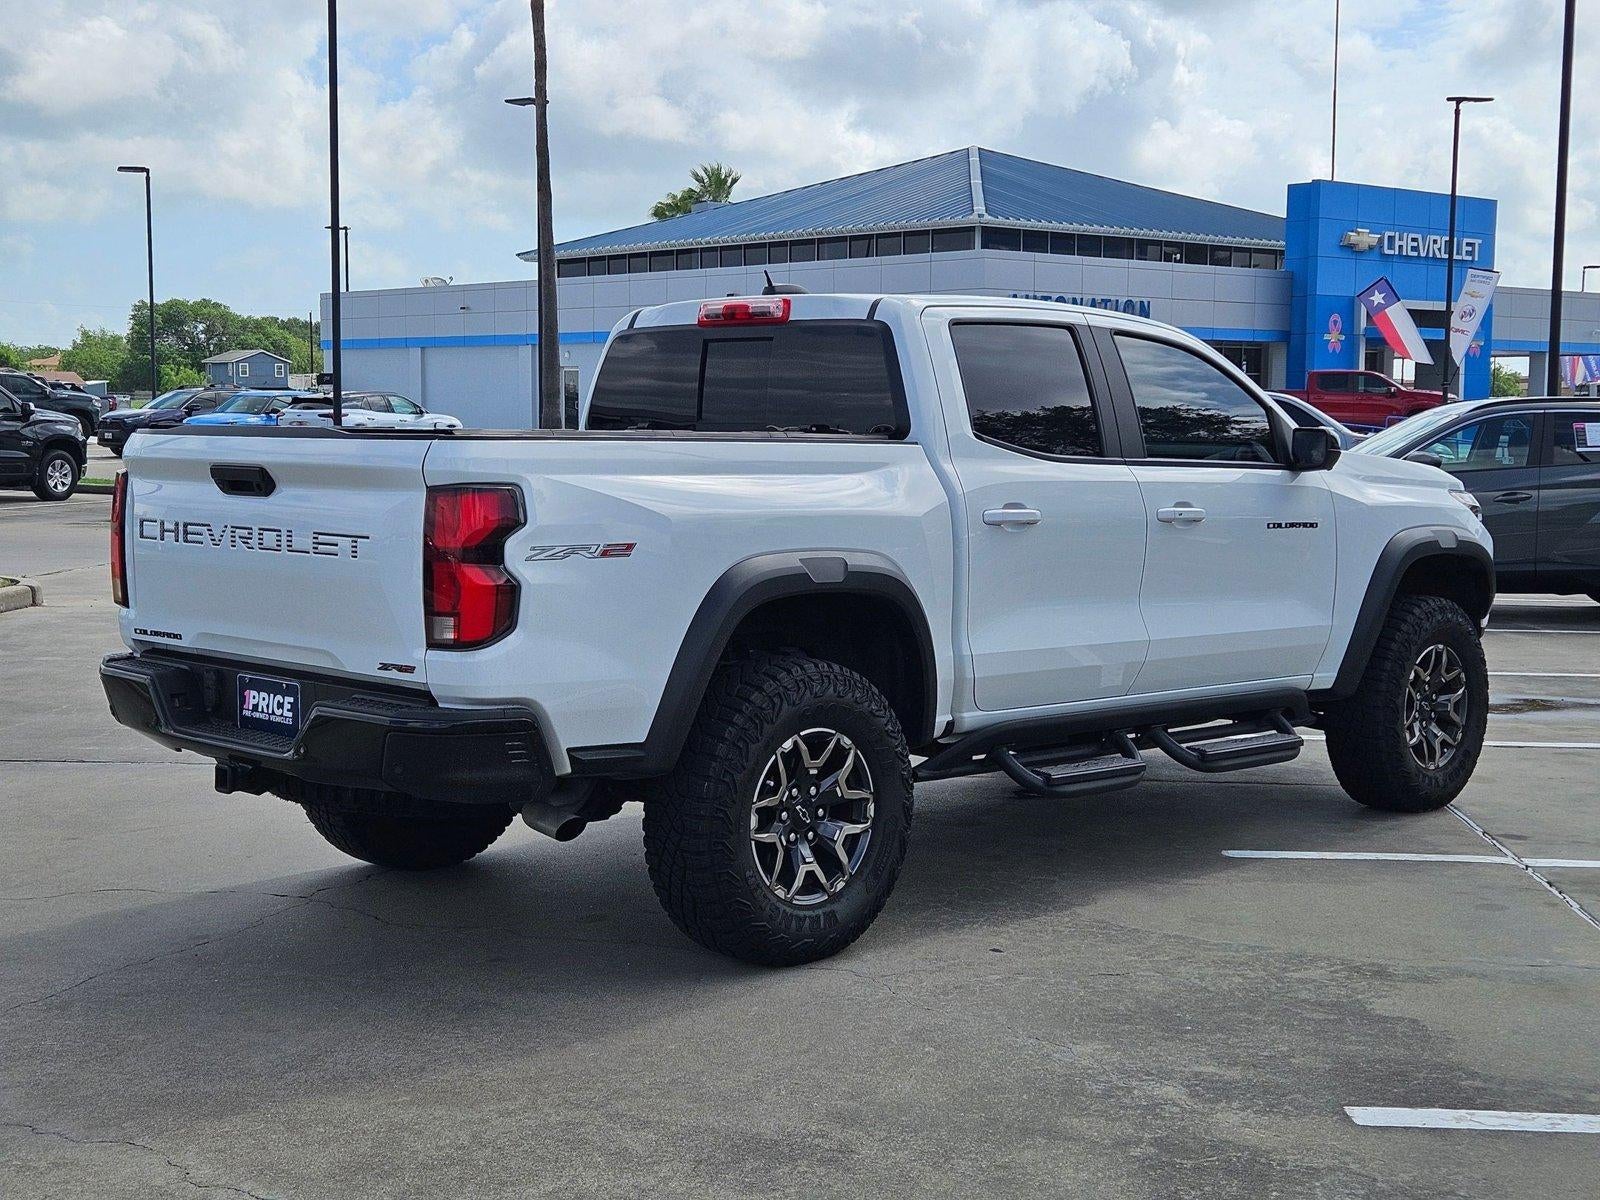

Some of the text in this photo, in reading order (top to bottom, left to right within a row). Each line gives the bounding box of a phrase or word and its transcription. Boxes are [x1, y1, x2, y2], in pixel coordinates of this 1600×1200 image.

[1383, 231, 1482, 261] CHEVROLET
[1010, 293, 1151, 319] NATION
[1266, 521, 1319, 530] COLORADO
[139, 517, 370, 559] CHEVROLET
[524, 542, 637, 562] ZR2
[133, 627, 183, 641] COLORADO
[376, 662, 416, 674] ZR2
[270, 714, 293, 725] VEHICLES
